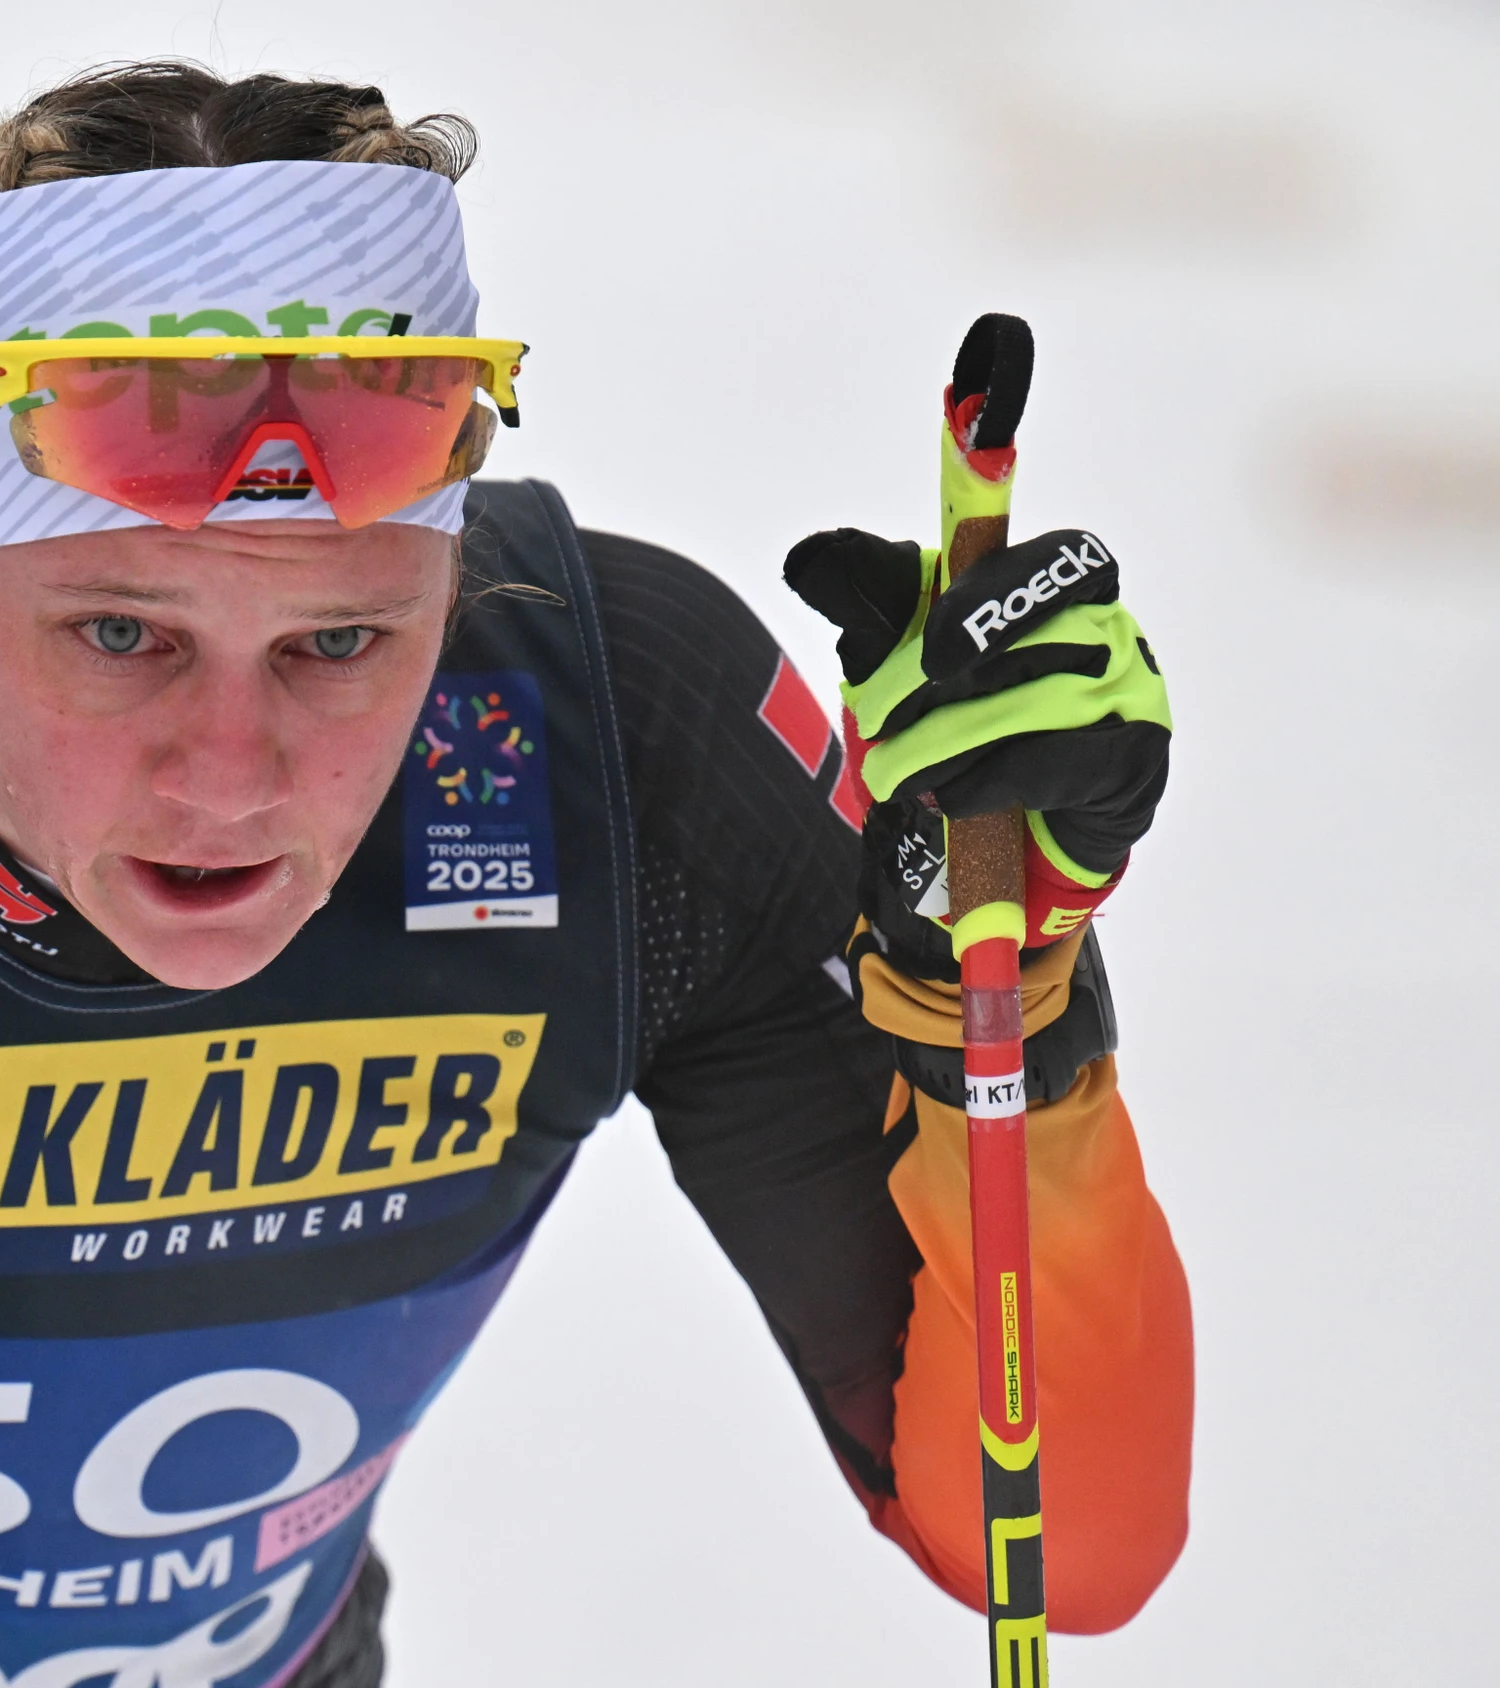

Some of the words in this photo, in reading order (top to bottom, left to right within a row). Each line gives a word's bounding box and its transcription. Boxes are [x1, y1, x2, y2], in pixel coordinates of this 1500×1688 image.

[427, 843, 531, 858] TRONDHEIM
[427, 860, 534, 891] 2025
[70, 1192, 408, 1263] WORKWEAR
[1003, 1276, 1016, 1349] NORDIC
[1006, 1351, 1020, 1420] SHARK
